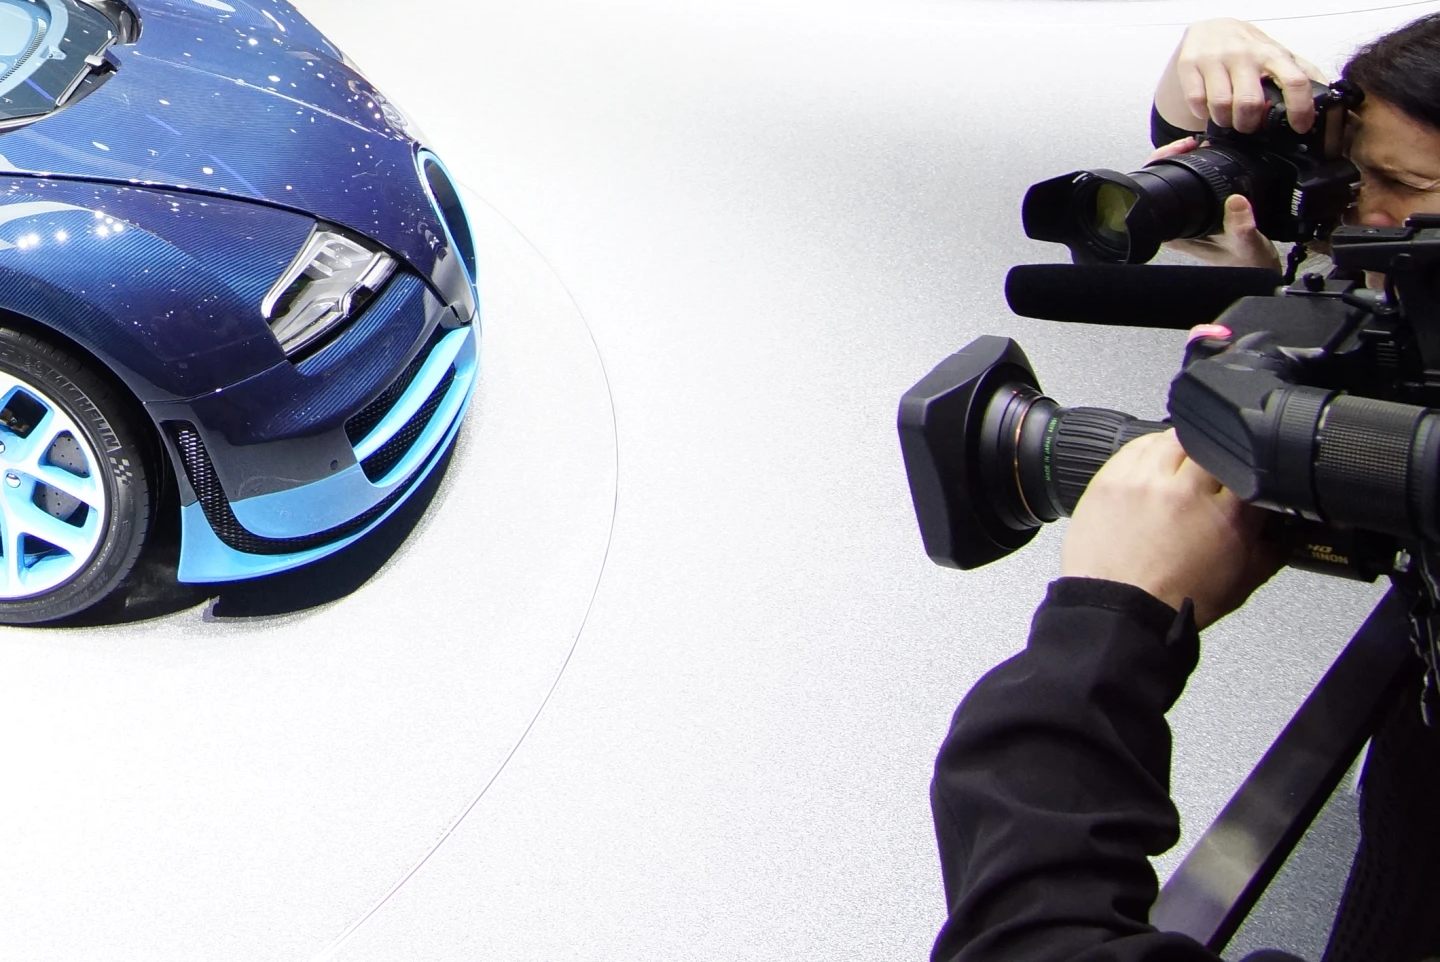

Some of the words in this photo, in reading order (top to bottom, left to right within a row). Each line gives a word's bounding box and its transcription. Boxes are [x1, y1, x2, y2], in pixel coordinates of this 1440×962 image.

[1290, 188, 1303, 216] Nikon
[44, 369, 122, 453] MICHELIN
[1044, 436, 1053, 455] JAPAN
